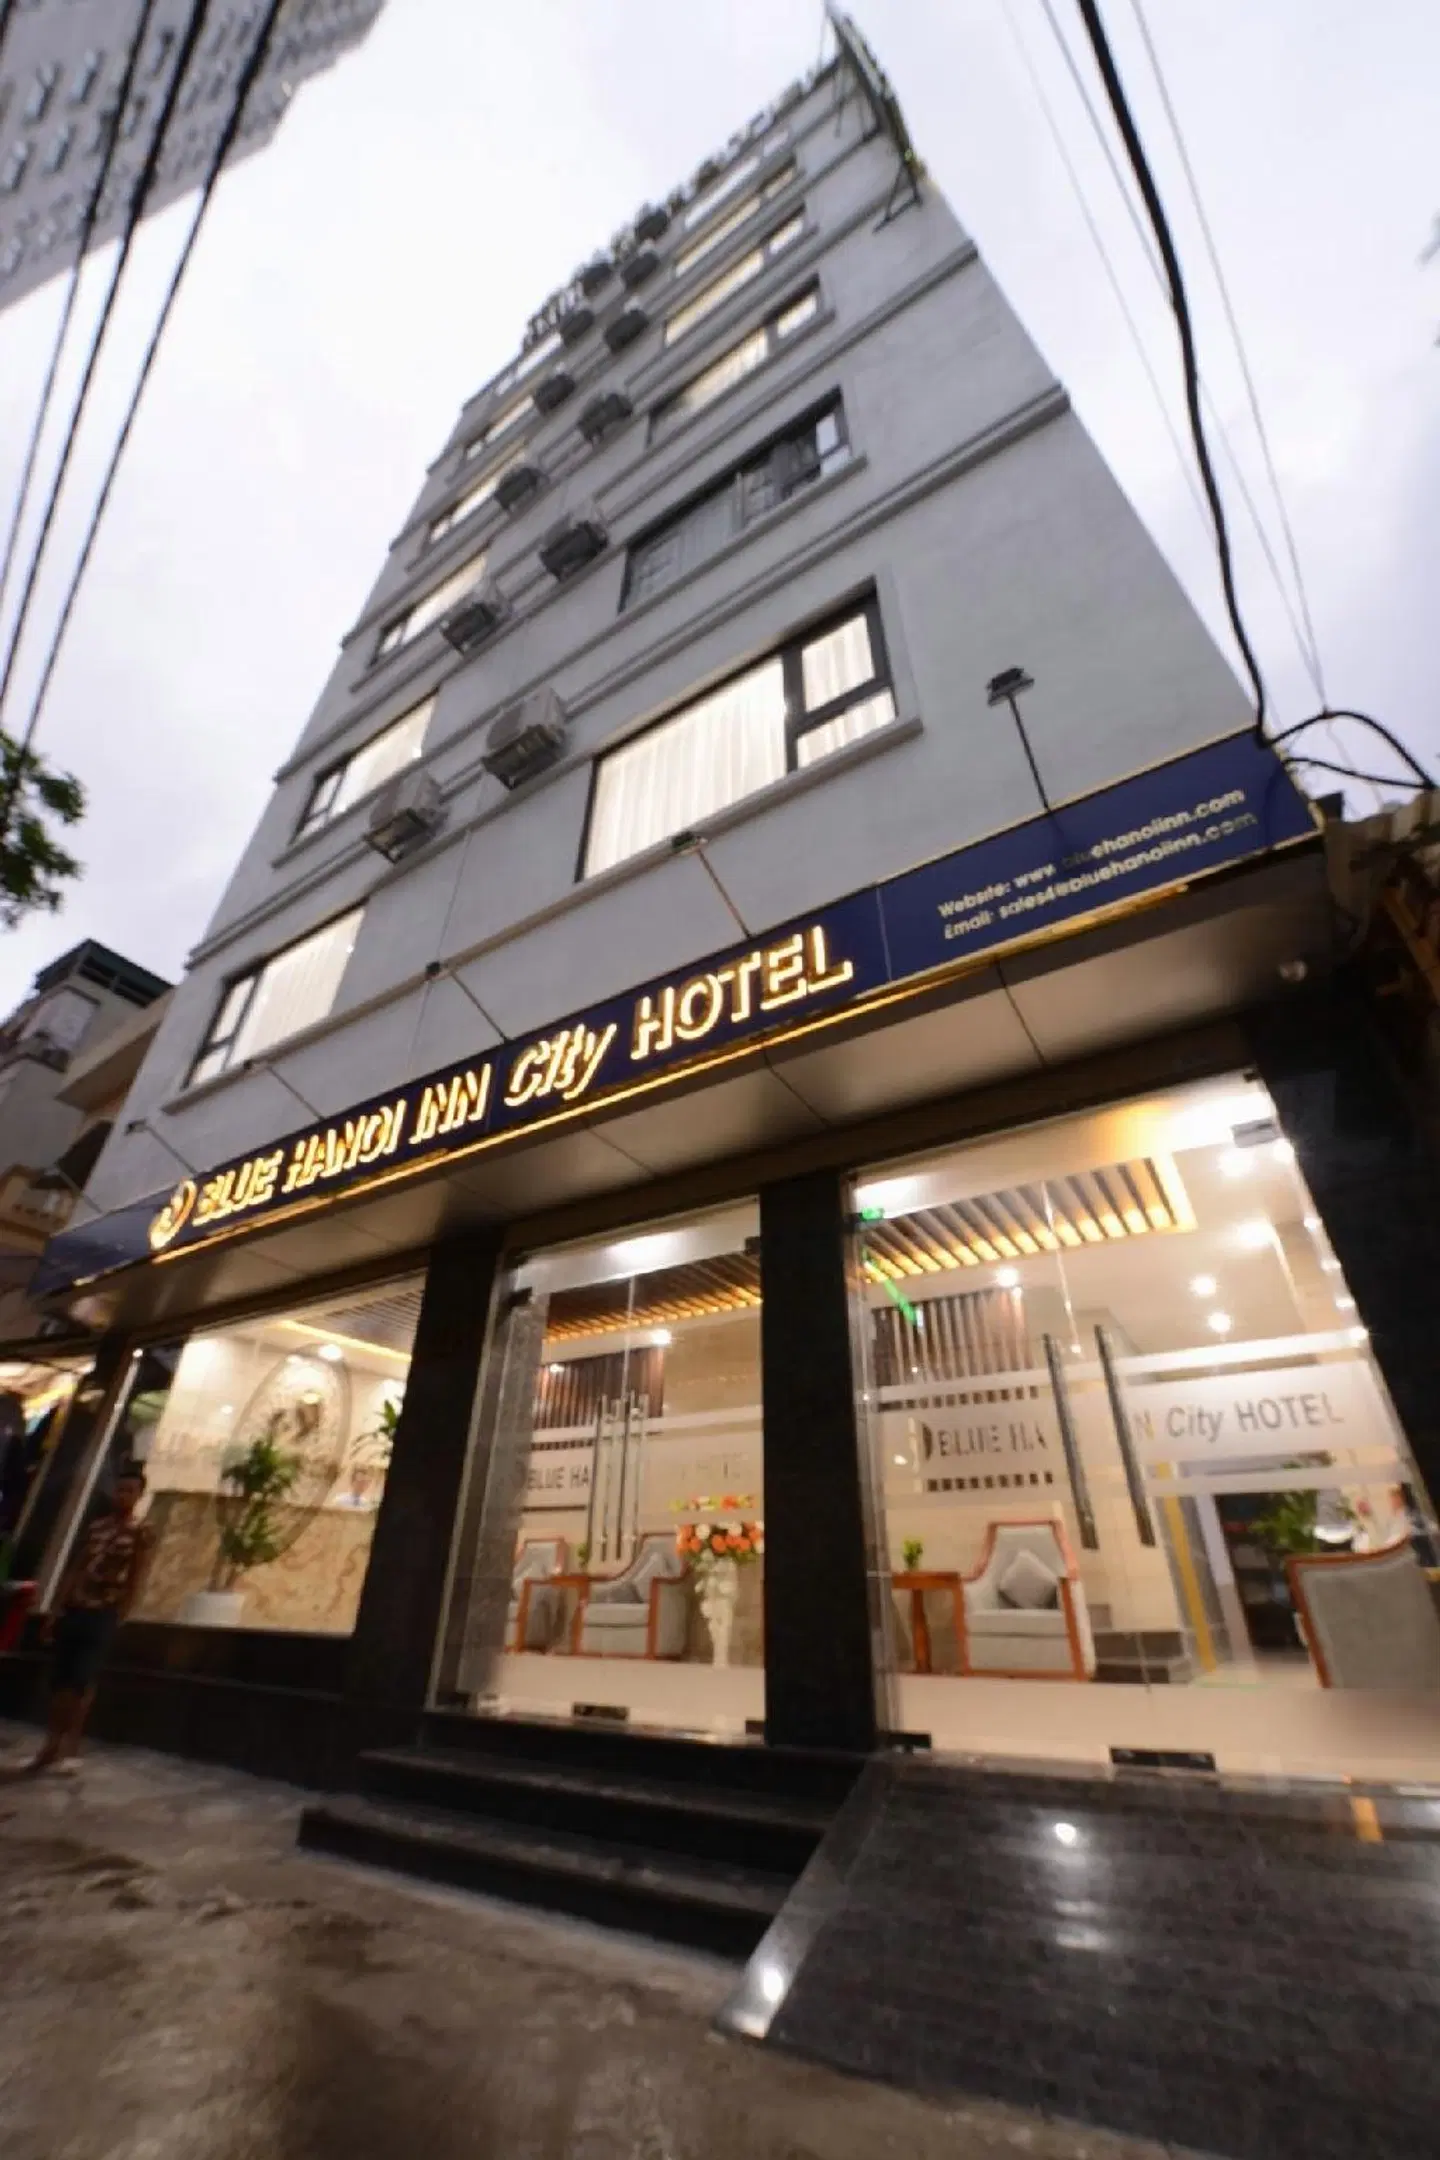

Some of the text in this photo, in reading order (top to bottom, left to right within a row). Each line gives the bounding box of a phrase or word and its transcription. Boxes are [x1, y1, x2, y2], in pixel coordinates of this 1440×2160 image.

[1013, 789, 1245, 888] wwwbluehanoiinn.com
[192, 925, 854, 1227] BLUE HANOI INN City HOTEL
[1166, 1404, 1224, 1443] City
[1234, 1391, 1345, 1433] HOTEL
